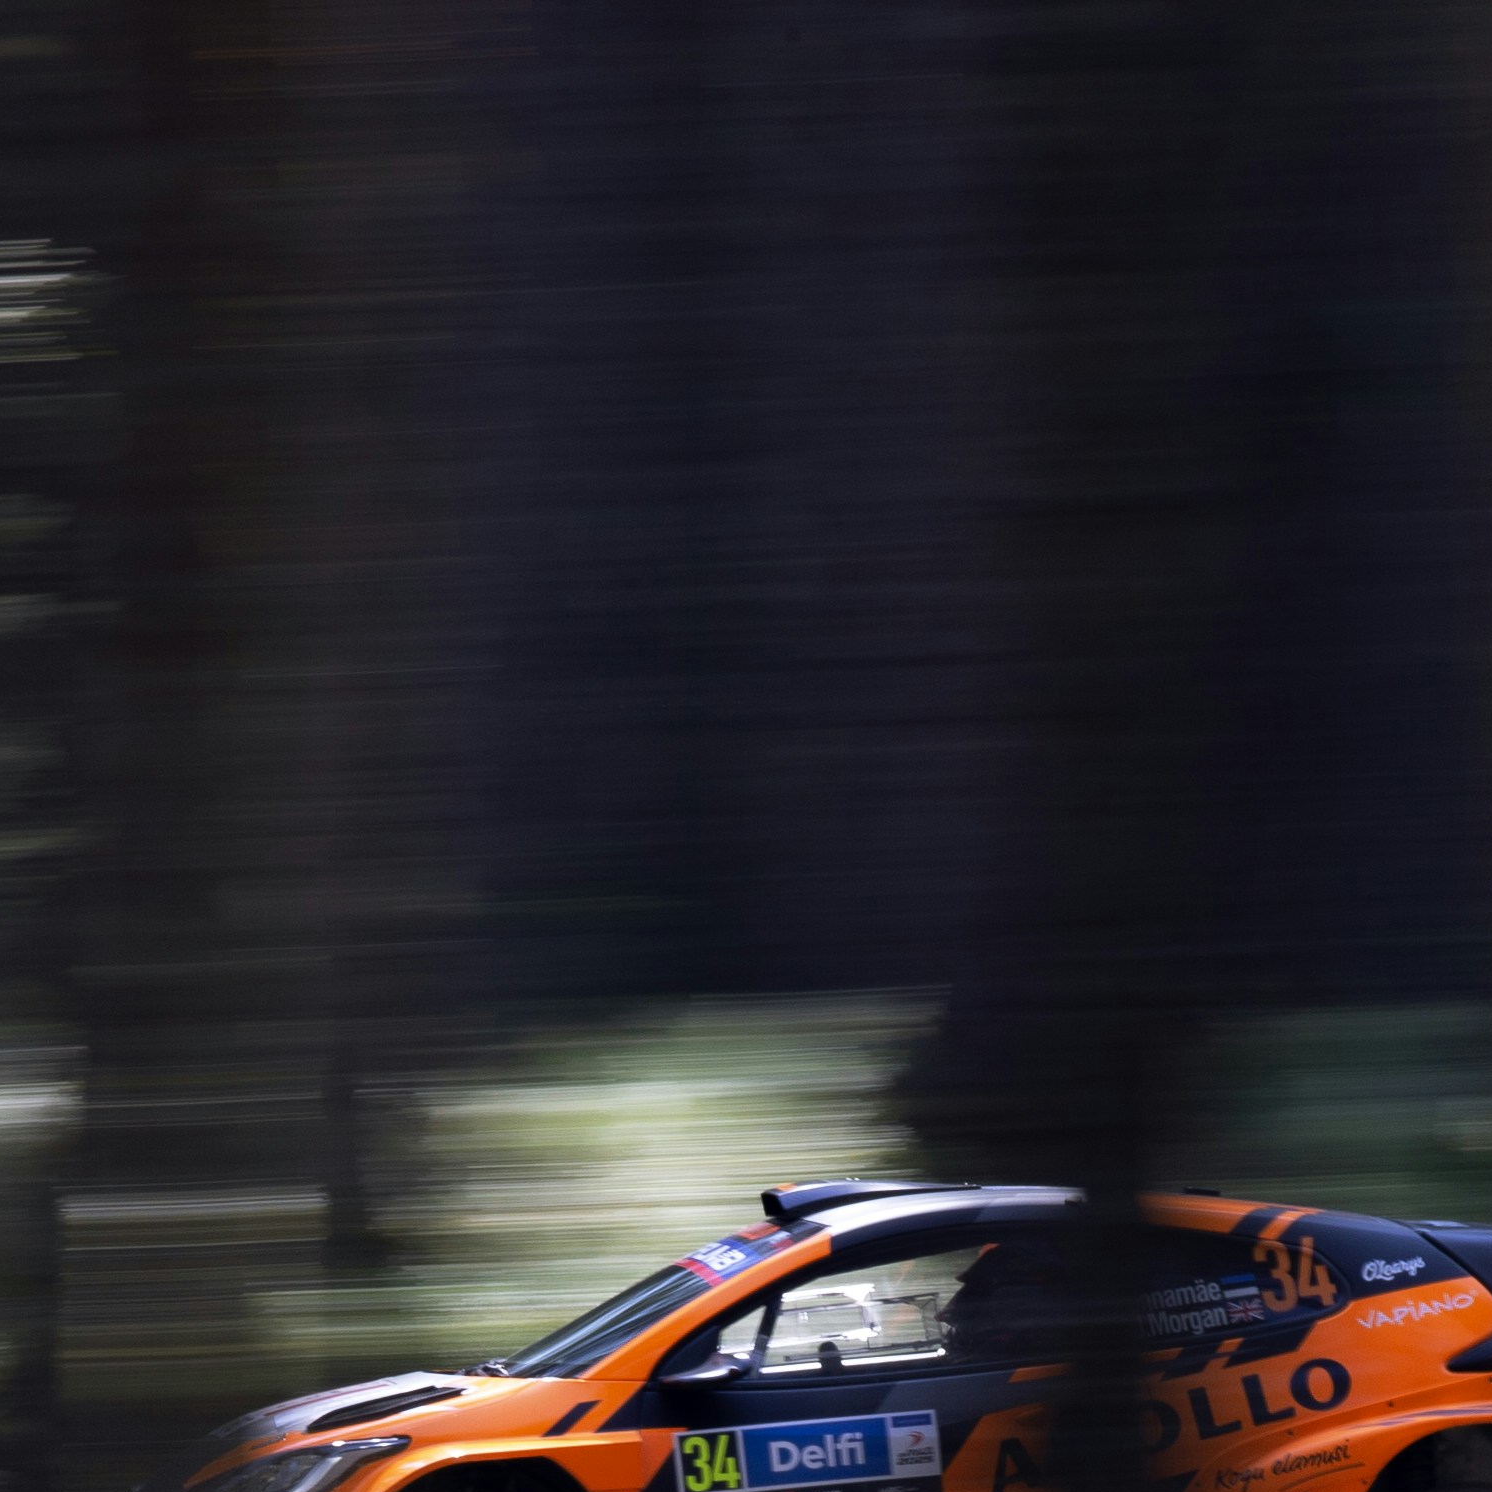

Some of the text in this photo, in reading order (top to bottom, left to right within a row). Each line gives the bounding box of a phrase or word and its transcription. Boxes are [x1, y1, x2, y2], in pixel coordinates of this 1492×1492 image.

[1252, 1236, 1338, 1313] 34
[682, 1433, 742, 1492] 34
[768, 1431, 867, 1474] Delfi
[1273, 1439, 1352, 1476] elamusi
